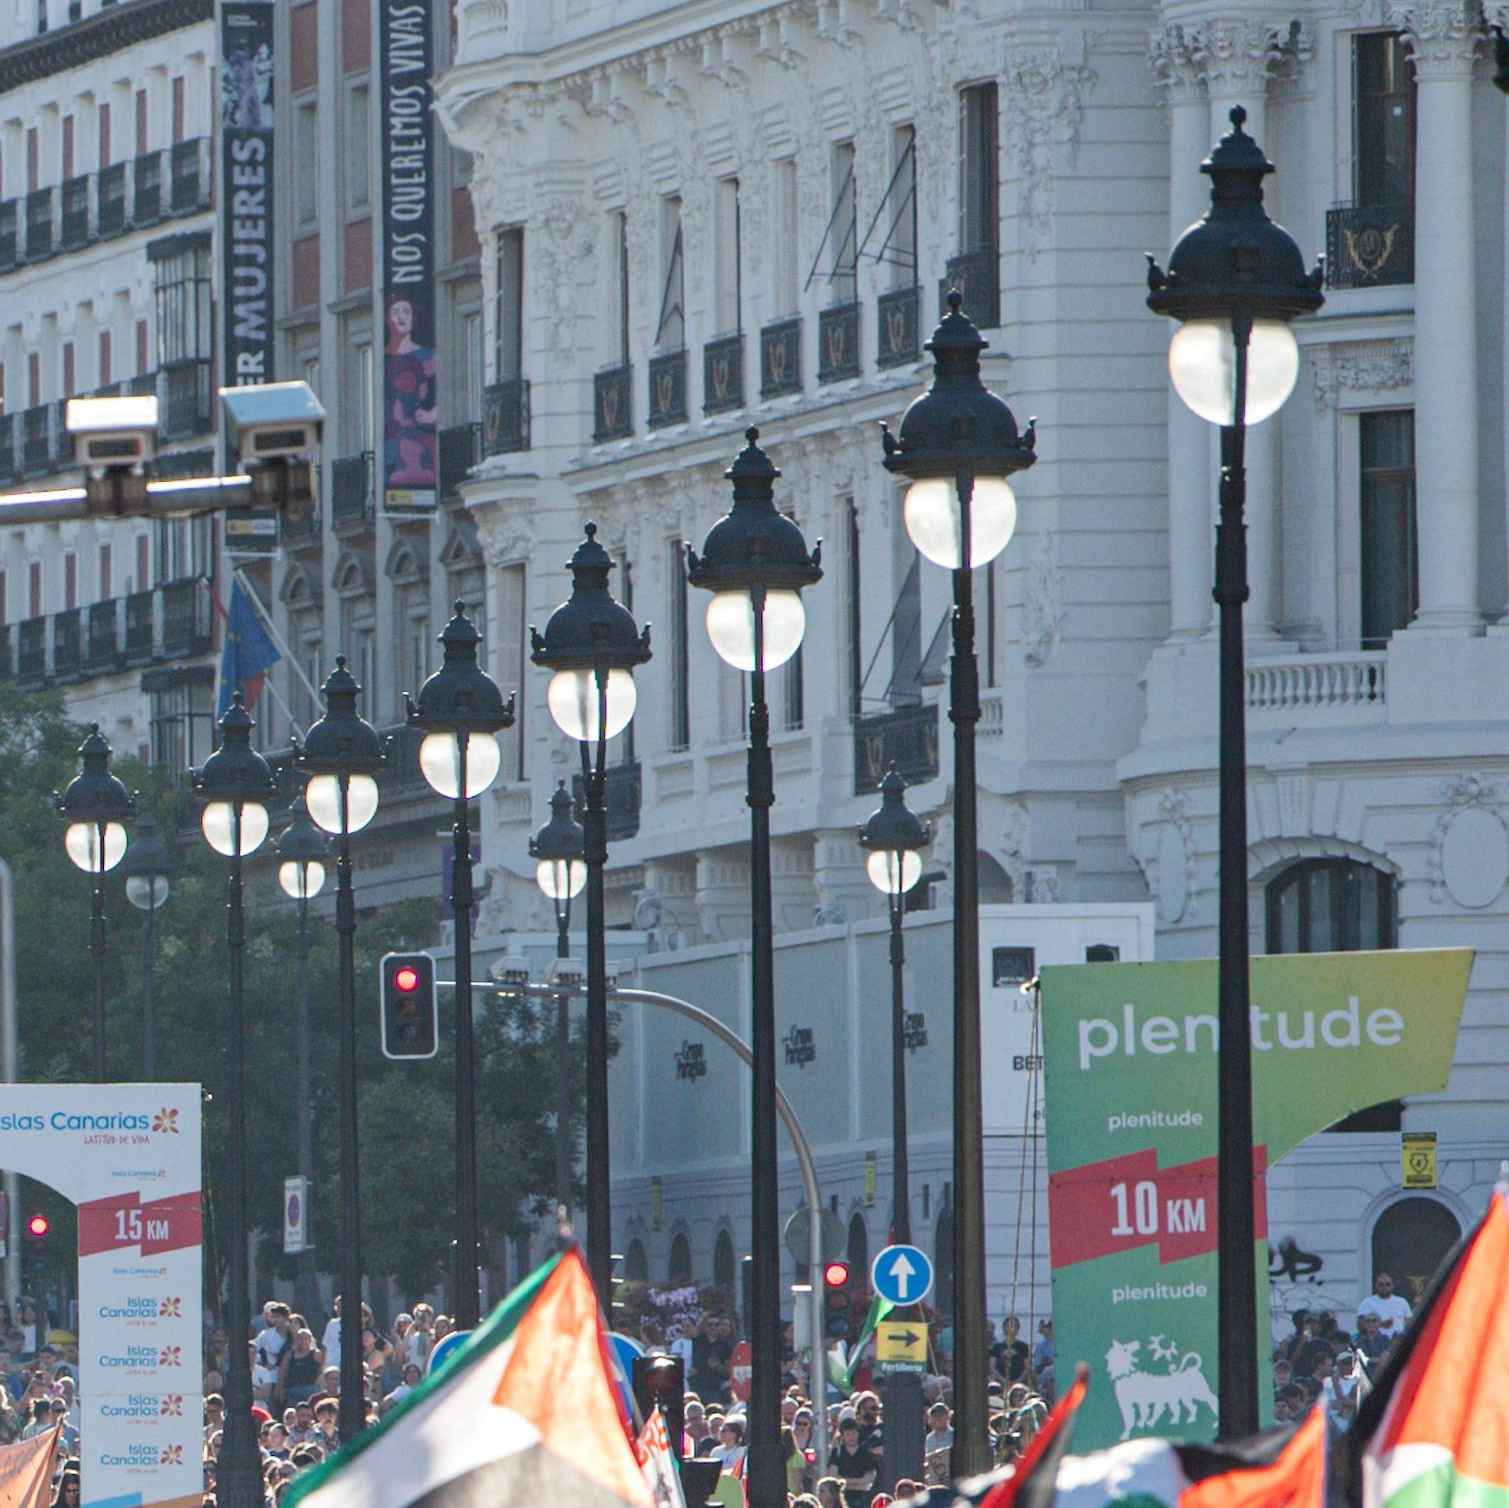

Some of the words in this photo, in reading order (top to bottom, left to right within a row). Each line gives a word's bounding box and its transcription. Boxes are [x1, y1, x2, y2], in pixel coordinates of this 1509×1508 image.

[389, 5, 425, 75] VIVAS
[390, 85, 426, 222] QUEREMOS
[233, 137, 267, 341] MUJERES
[392, 233, 426, 283] NOS
[1079, 996, 1404, 1070] plentude
[1013, 1055, 1043, 1071] BET
[50, 1111, 149, 1131] Canarias
[1108, 1110, 1204, 1132] plenitude
[84, 1135, 115, 1145] LATITUD
[132, 1135, 150, 1144] VIDA
[1111, 1180, 1159, 1236] 10
[1167, 1198, 1206, 1233] KM
[115, 1209, 143, 1241] 15
[147, 1220, 169, 1240] KM
[127, 1296, 157, 1308] Islas
[1112, 1283, 1208, 1304] plenitude
[99, 1306, 157, 1318] Canarias
[127, 1345, 157, 1357] Islas
[99, 1355, 157, 1367] Canarias
[128, 1394, 158, 1406] Islas
[100, 1404, 158, 1417] Canarias
[128, 1444, 158, 1456] Islas
[100, 1454, 158, 1466] Canarias
